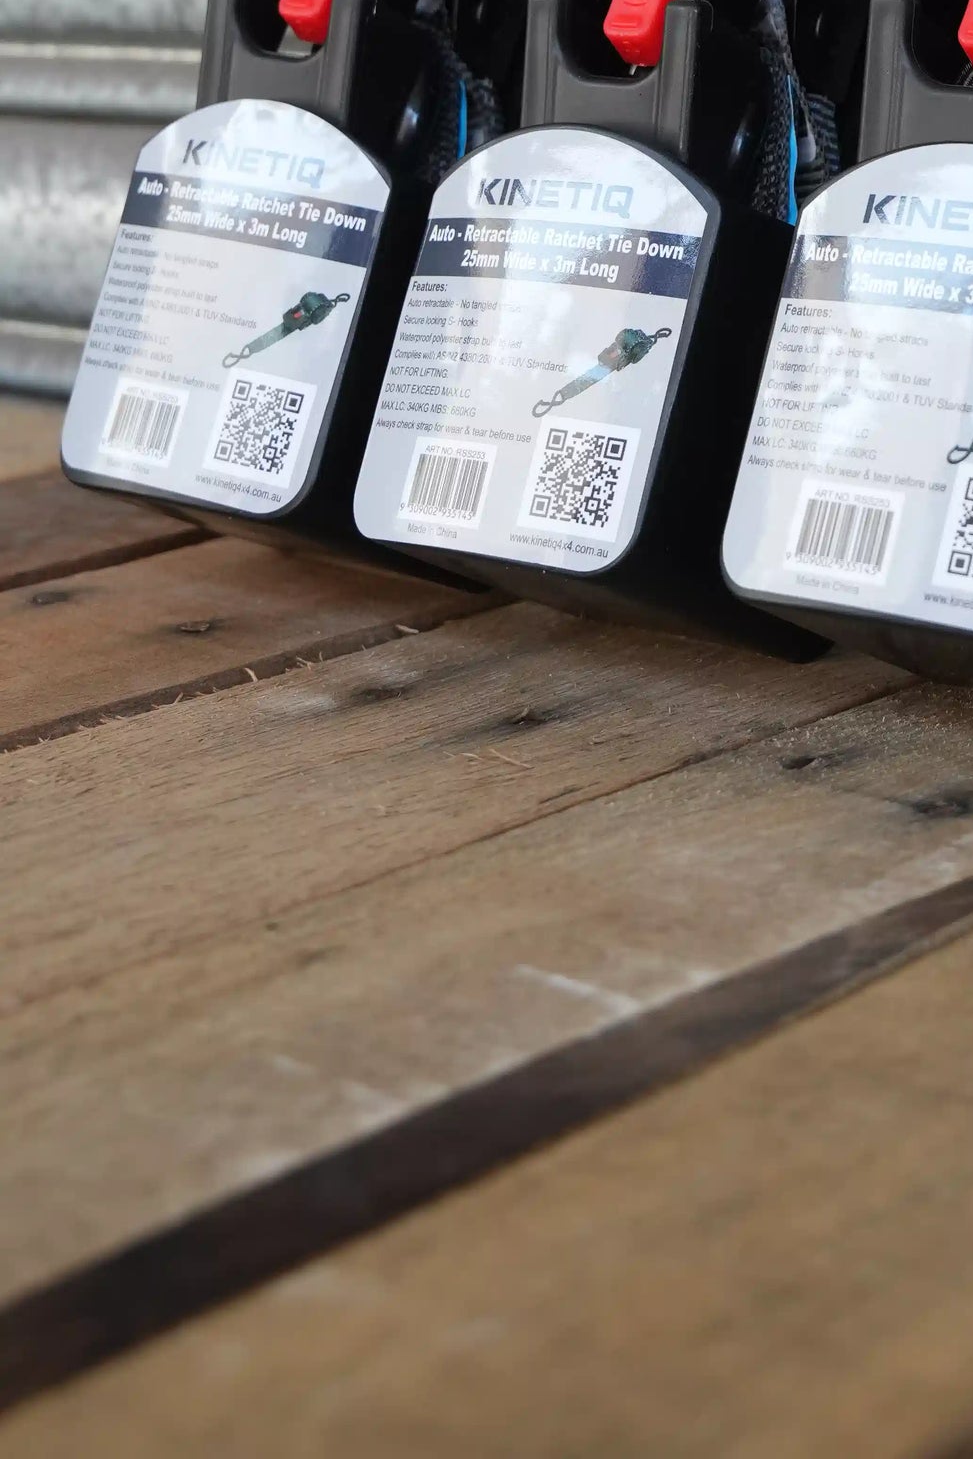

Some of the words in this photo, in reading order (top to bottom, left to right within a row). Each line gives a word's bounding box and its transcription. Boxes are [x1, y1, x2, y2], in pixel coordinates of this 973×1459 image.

[181, 138, 328, 189] KINETIQ
[136, 177, 165, 195] Auto
[241, 191, 296, 217] Ratchet
[296, 200, 323, 222] Tie
[322, 204, 368, 232] Down
[474, 177, 637, 219] KINETIQ
[165, 205, 203, 225] 25mm
[201, 209, 236, 231] Wide
[235, 219, 247, 233] x
[247, 217, 271, 237] 3m
[270, 221, 309, 249] Long
[428, 224, 457, 241] Auto
[462, 224, 541, 244] Retractable
[542, 227, 604, 250] Ratchet
[605, 232, 634, 253] Tie
[635, 234, 686, 260] Down
[804, 241, 841, 262] Auto
[850, 243, 949, 272] Retractable
[460, 249, 501, 267] 25mm
[500, 250, 538, 270] Wide
[538, 257, 550, 271] x
[552, 254, 578, 274] 3m
[578, 256, 620, 284] Long
[410, 281, 448, 292] Features:
[899, 275, 946, 300] Wide
[946, 286, 961, 302] x
[406, 298, 423, 307] Auto
[421, 298, 455, 307] retractable
[459, 299, 471, 308] No
[469, 300, 497, 312] tangled
[784, 303, 833, 318] Features:
[402, 315, 425, 324] Secure
[423, 316, 447, 327] locking
[456, 316, 480, 326] Hooks
[779, 322, 800, 333] Auto
[849, 327, 864, 338] No
[397, 332, 432, 344] Waterproof
[431, 334, 463, 345] polyester
[461, 335, 481, 347] strap
[775, 342, 804, 353] Secure
[393, 349, 423, 361] Complies
[421, 350, 437, 360] with
[525, 358, 569, 373] Standards
[770, 360, 815, 376] Waterproof
[388, 366, 405, 375] NOT
[403, 366, 420, 376] FOR
[384, 383, 396, 393] DO
[394, 383, 411, 393] NOT
[410, 384, 441, 396] EXCEED
[439, 386, 459, 397] MAX
[458, 388, 472, 398] LC
[765, 380, 804, 395] Complies
[379, 400, 395, 410] MAX
[405, 401, 430, 413] 340KG
[780, 398, 802, 410] FOR
[374, 417, 397, 430] Always
[395, 419, 415, 430] check
[414, 420, 433, 433] strap
[433, 422, 444, 432] for
[444, 425, 463, 434] wear
[471, 426, 488, 437] tear
[488, 428, 515, 441] before
[515, 434, 531, 443] use
[756, 416, 771, 427] DO
[769, 417, 792, 429] NOT
[751, 435, 771, 447] MAX
[424, 444, 440, 454] ART
[746, 454, 775, 469] Always
[193, 473, 283, 501] www.kinetiq4x4.com.au
[406, 522, 427, 534] Made
[435, 526, 458, 539] China
[507, 534, 610, 556] www.kinetiq4x4.com.au
